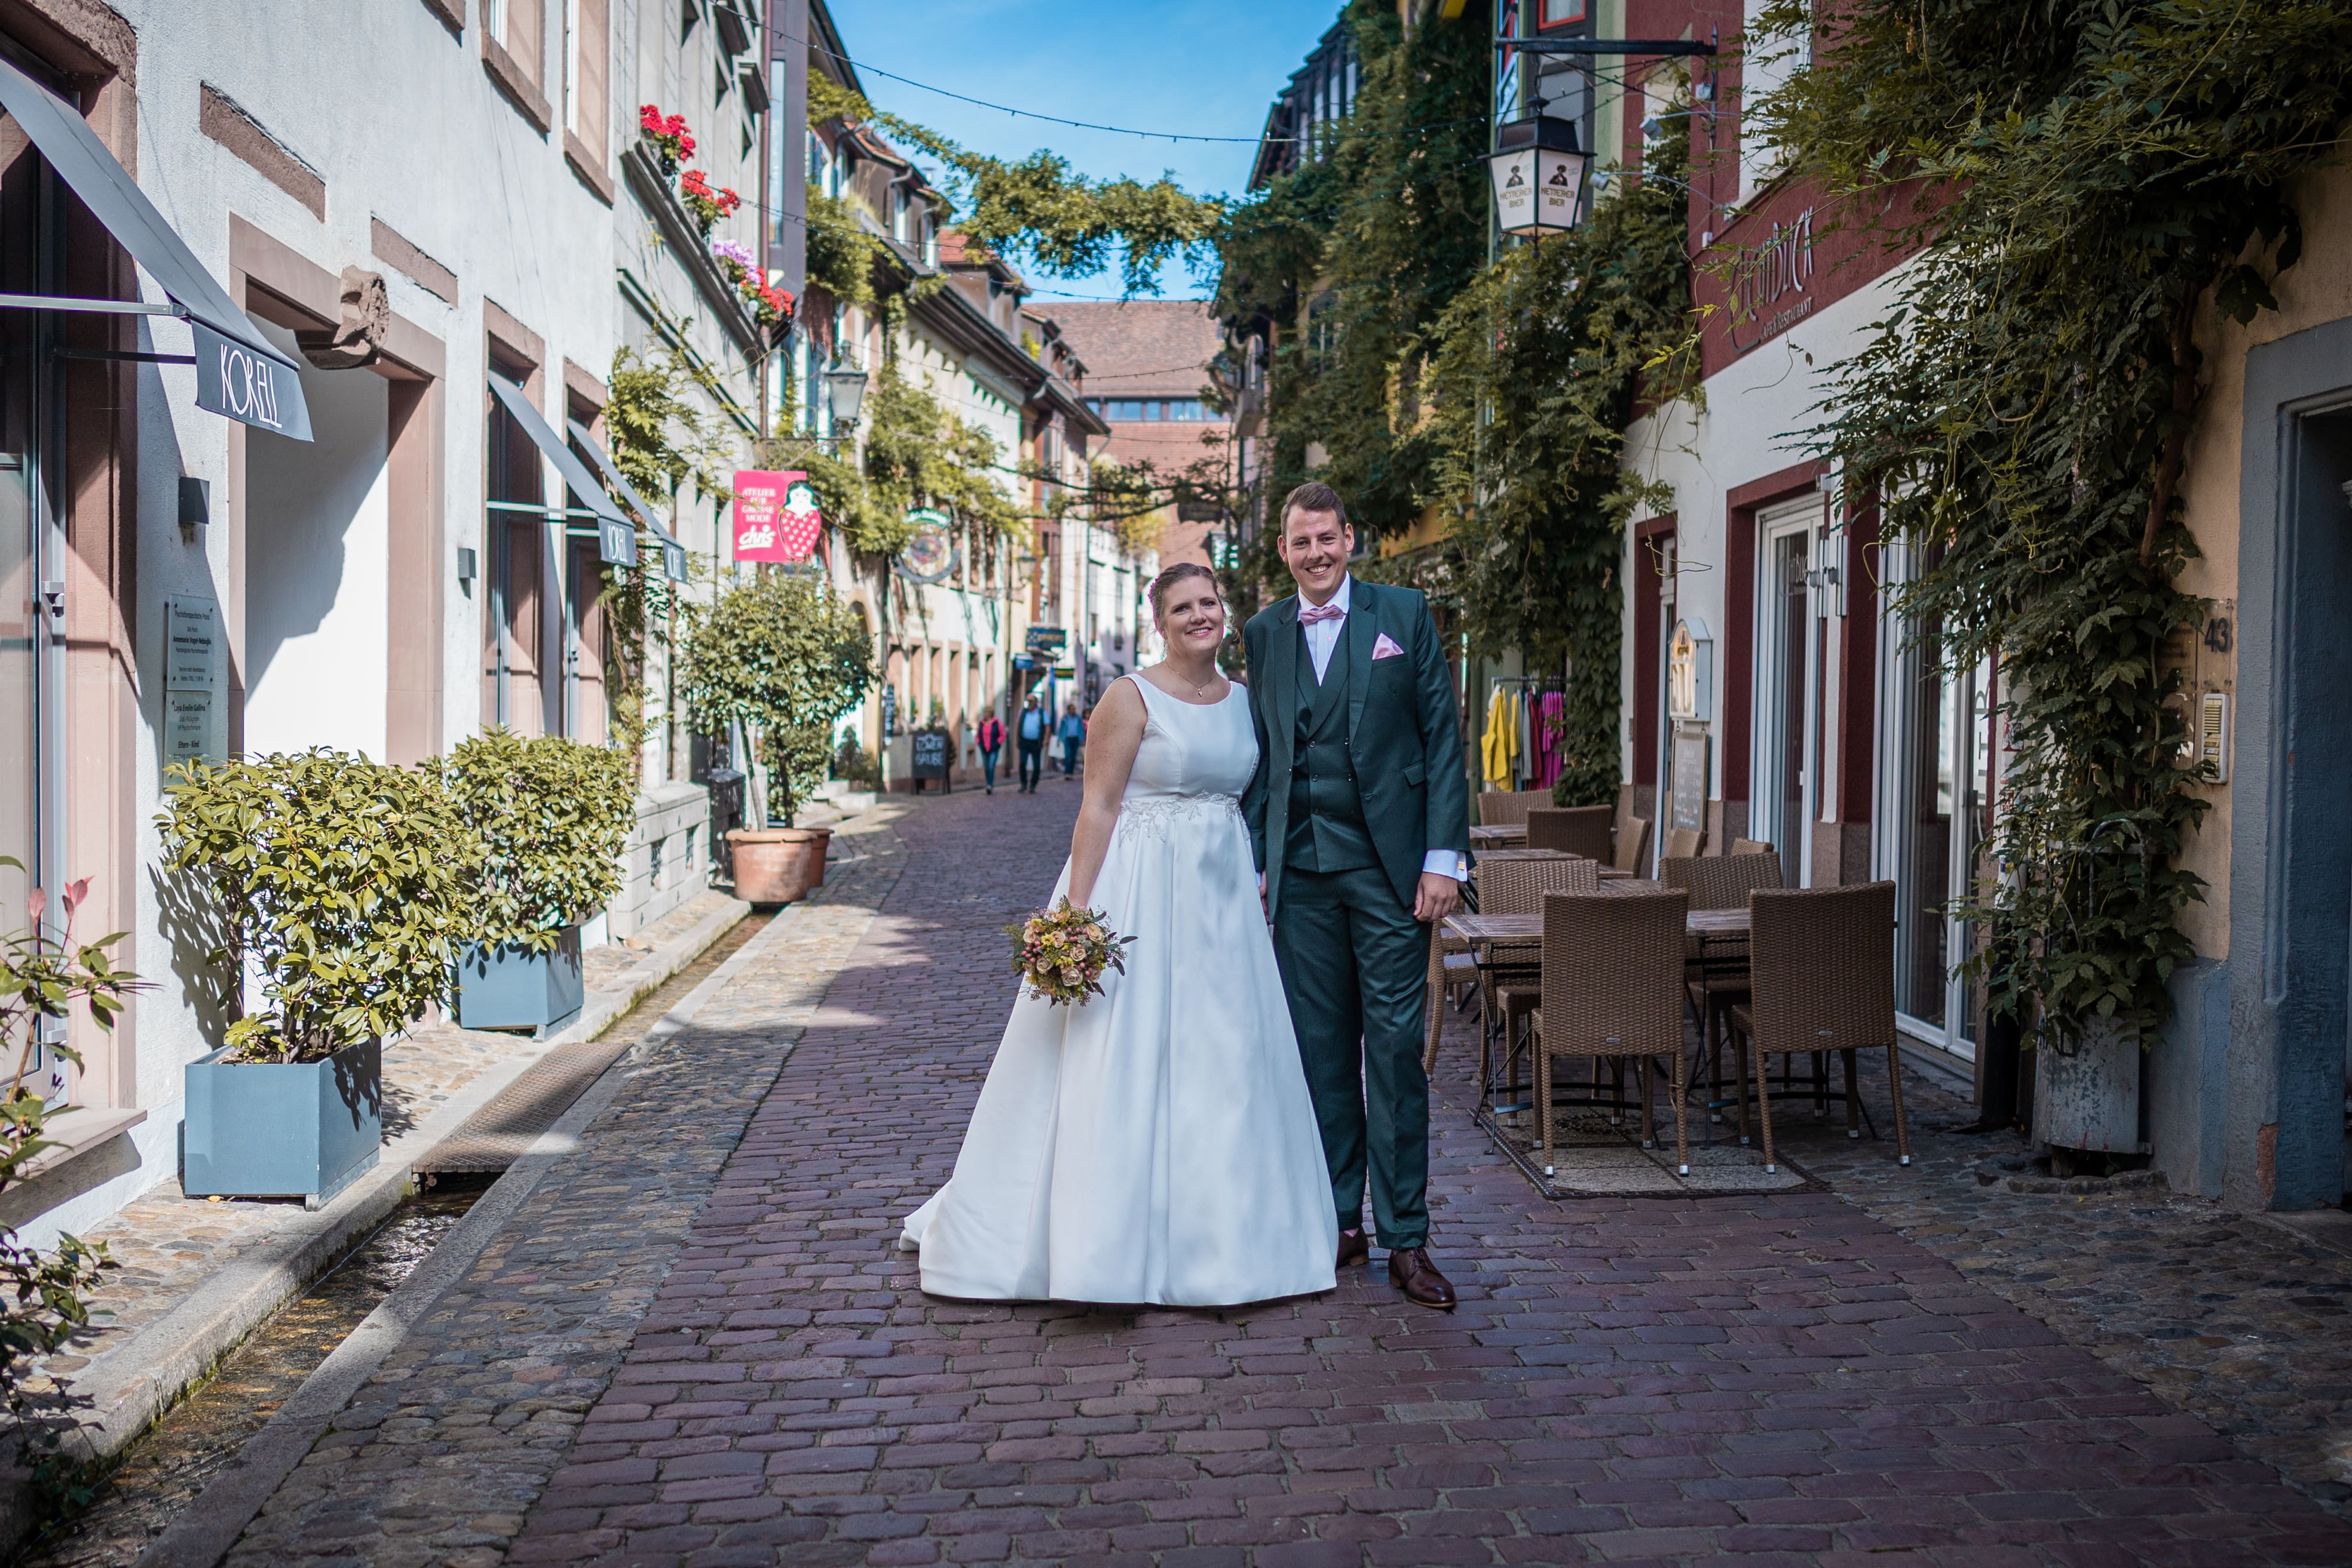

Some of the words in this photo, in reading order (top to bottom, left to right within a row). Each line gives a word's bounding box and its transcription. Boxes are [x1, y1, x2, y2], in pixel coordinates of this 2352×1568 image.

[1509, 198, 1524, 208] BIER
[1549, 198, 1565, 207] BIER
[220, 344, 283, 428] KORELL
[742, 488, 775, 497] ATELIER
[2204, 617, 2229, 652] 43
